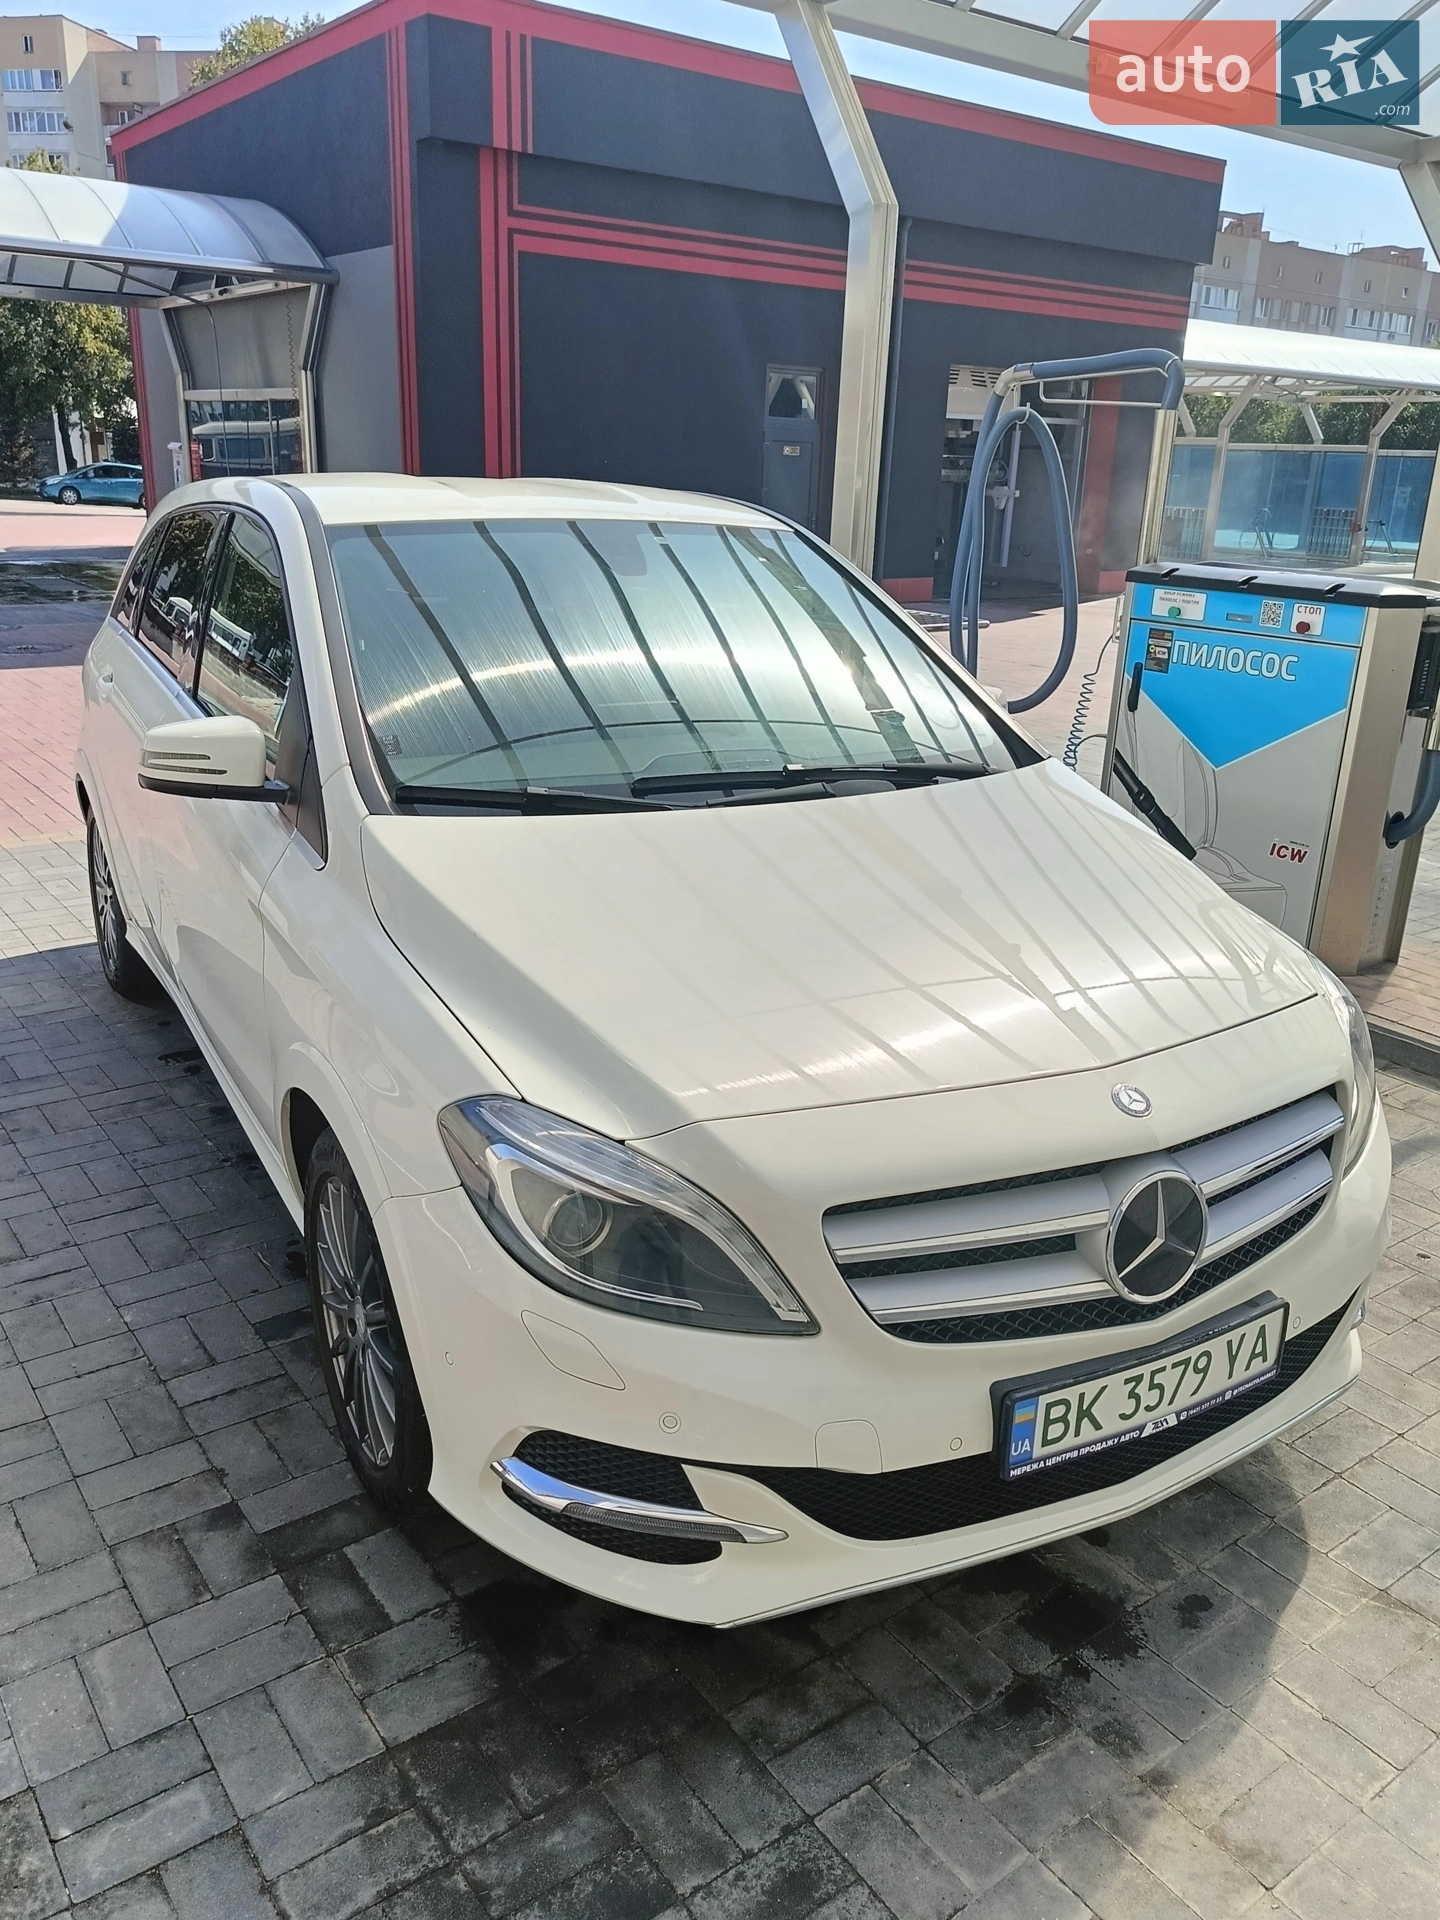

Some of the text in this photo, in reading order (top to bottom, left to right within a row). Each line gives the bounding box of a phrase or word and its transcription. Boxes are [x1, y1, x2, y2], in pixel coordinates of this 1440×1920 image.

[1296, 605, 1322, 616] СТОП
[1172, 640, 1300, 682] ПИЛОСОС
[1269, 842, 1308, 864] ICW
[1041, 1324, 1269, 1448] BK 3579 YA
[1009, 1430, 1140, 1478] МЕРЕЖА ЦЕНТРІВ ПРОДАЖУ АВТО
[1011, 1438, 1031, 1456] UA
